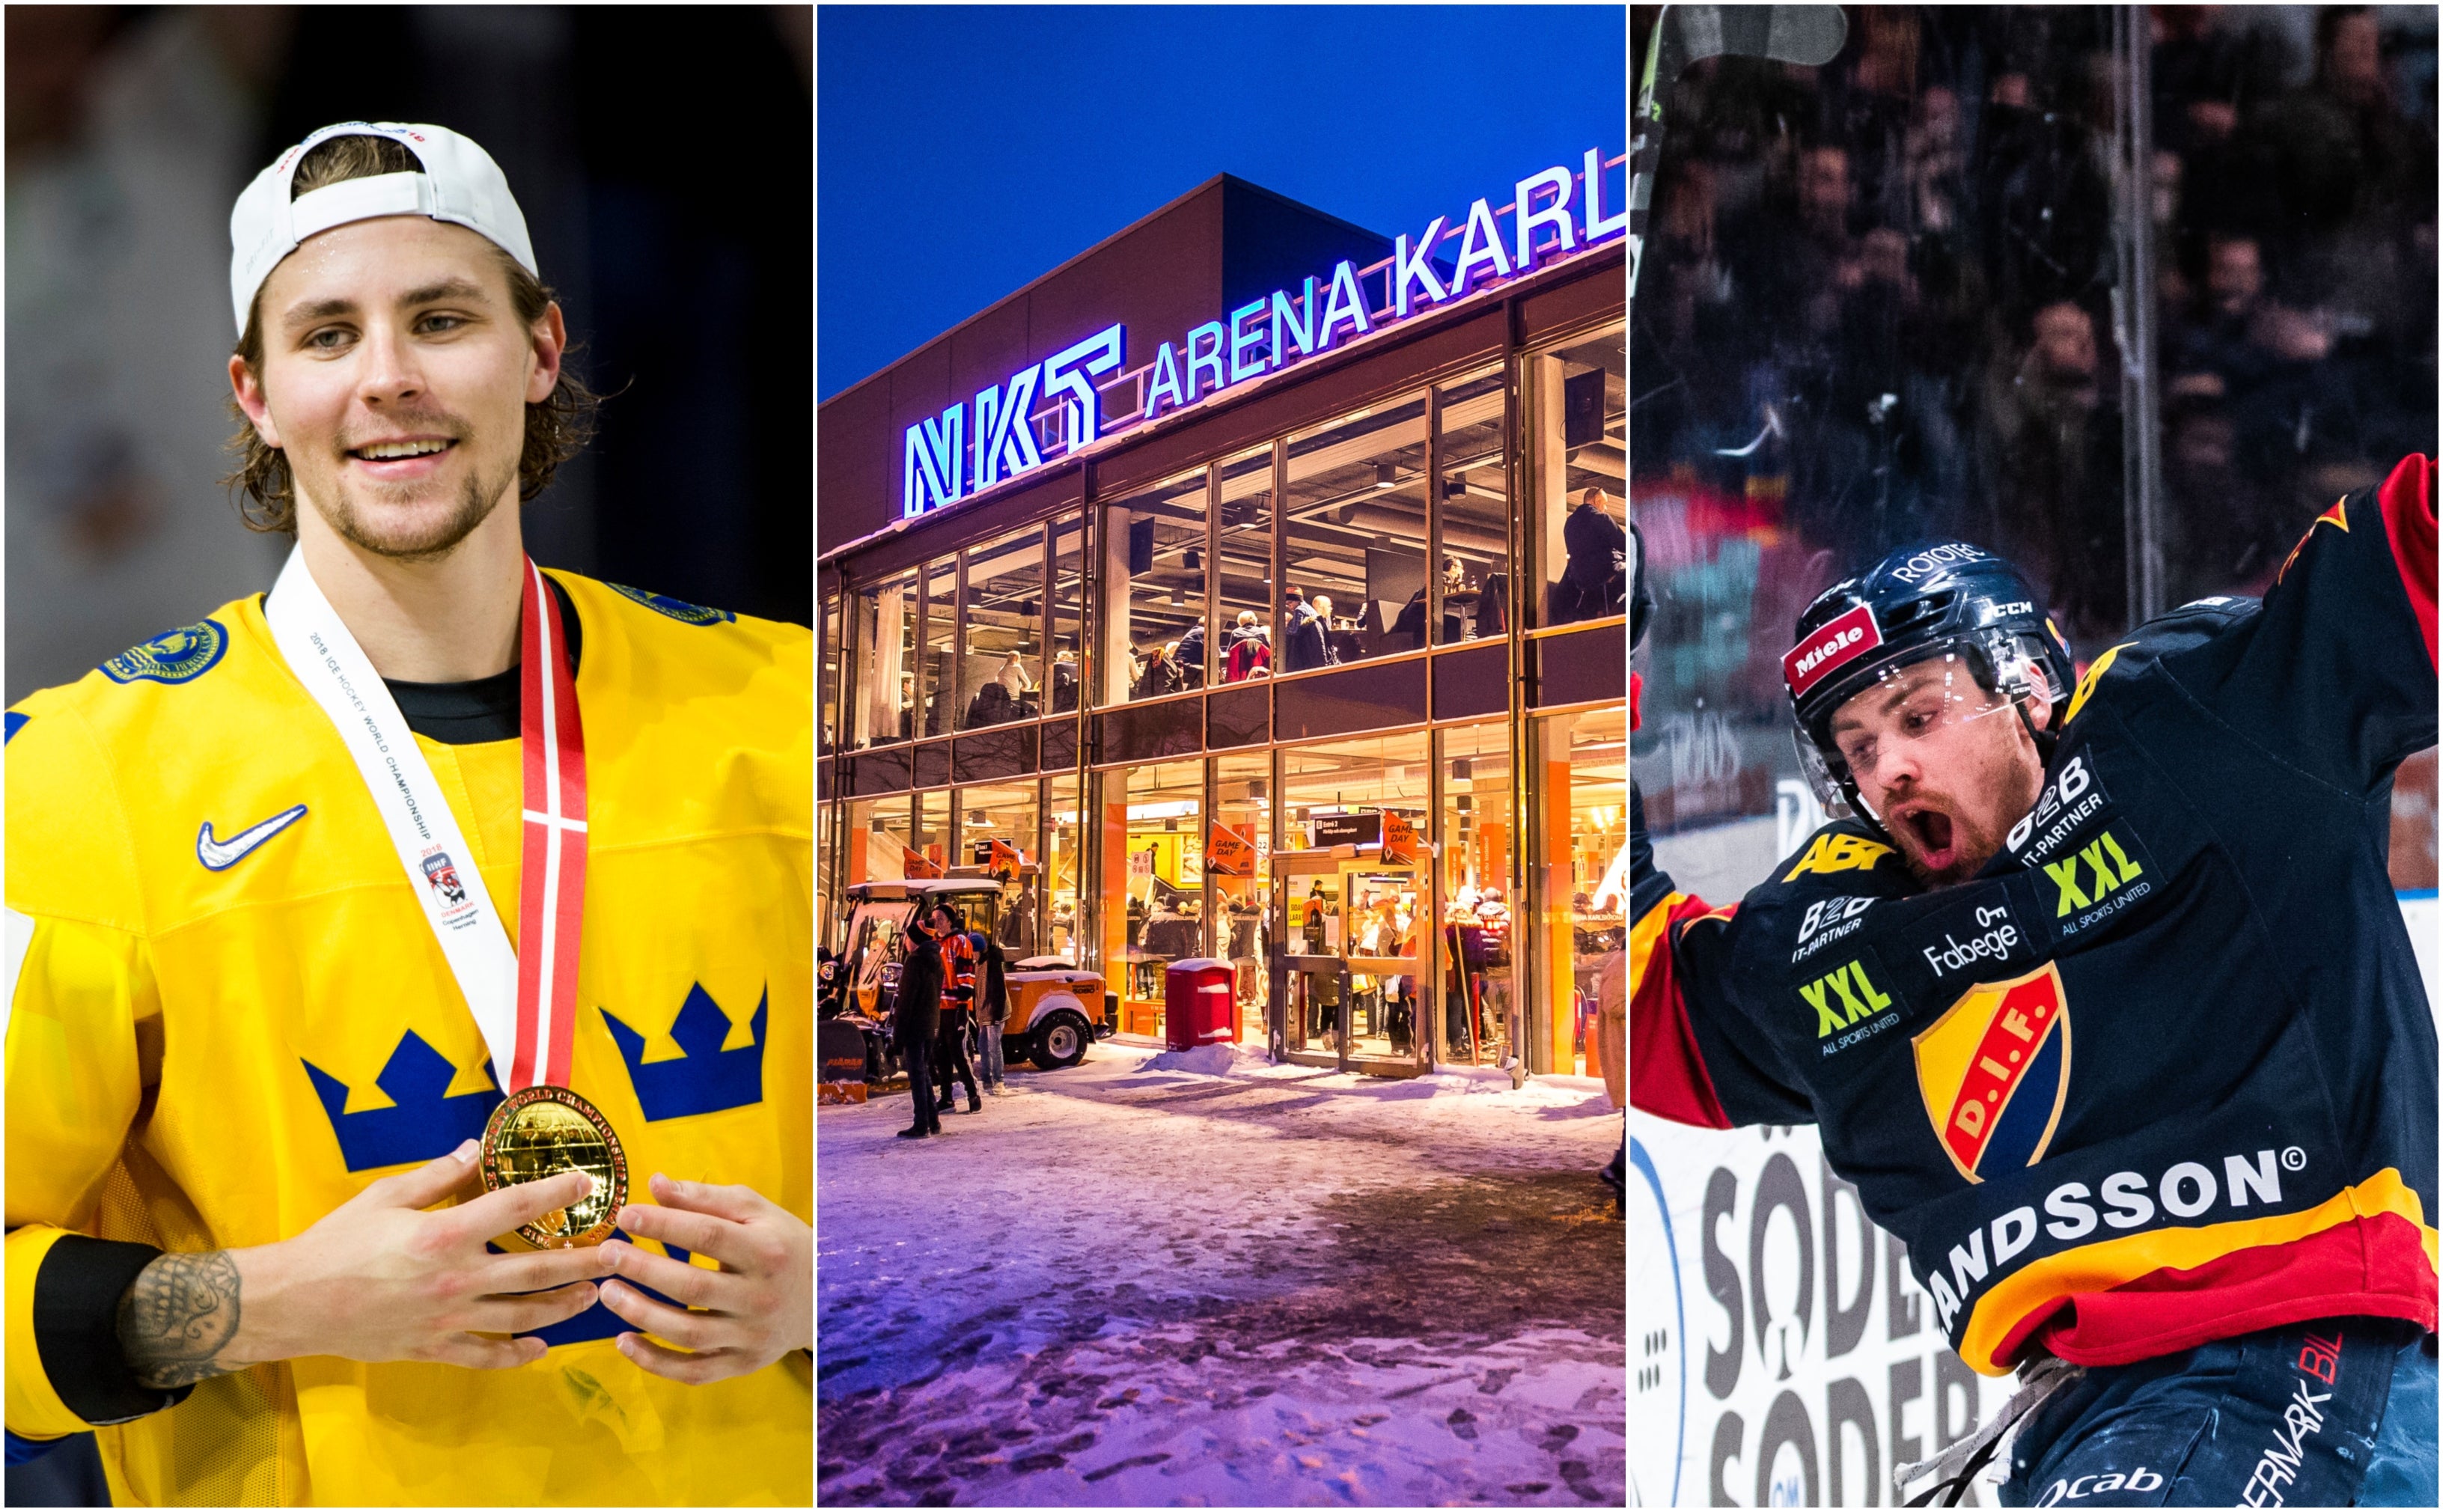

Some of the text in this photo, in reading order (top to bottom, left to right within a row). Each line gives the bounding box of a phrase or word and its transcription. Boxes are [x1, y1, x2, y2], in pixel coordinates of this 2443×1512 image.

[903, 147, 1626, 519] NKT ARENA KARL
[1891, 543, 1986, 584] ROTOTEC
[1993, 601, 2034, 618] CCM
[1794, 626, 1864, 679] Miele
[309, 632, 431, 841] 2018 ICE HOCKEY WORLD CHAMPIONSHIP
[420, 844, 442, 857] 2018
[1216, 840, 1242, 850] GAME
[1216, 848, 1236, 856] DAY
[1388, 824, 1414, 834] GAME
[1391, 834, 1409, 843] DAY
[2020, 792, 2103, 868] IT-PARTNER
[426, 858, 448, 871] IIHF
[2042, 830, 2144, 919] XXL
[440, 900, 475, 918] DENMARK
[442, 909, 479, 926] Copenhagen
[2061, 882, 2151, 936] ALL SPORTS UNITED
[1791, 917, 1862, 963] IT-PARTNER
[1923, 924, 2019, 978] Fabege
[1798, 959, 1893, 1039] XXL
[1822, 1013, 1900, 1057] ALL SPORTS UNITED
[1954, 1005, 2047, 1140] D.I.F.
[507, 1088, 554, 1111] WORLD
[556, 1092, 626, 1181] CHAMPIONSHIP
[1702, 1125, 1939, 1400] SÖDE
[2298, 1332, 2343, 1386] BIL
[2236, 1378, 2332, 1508] ERMARK
